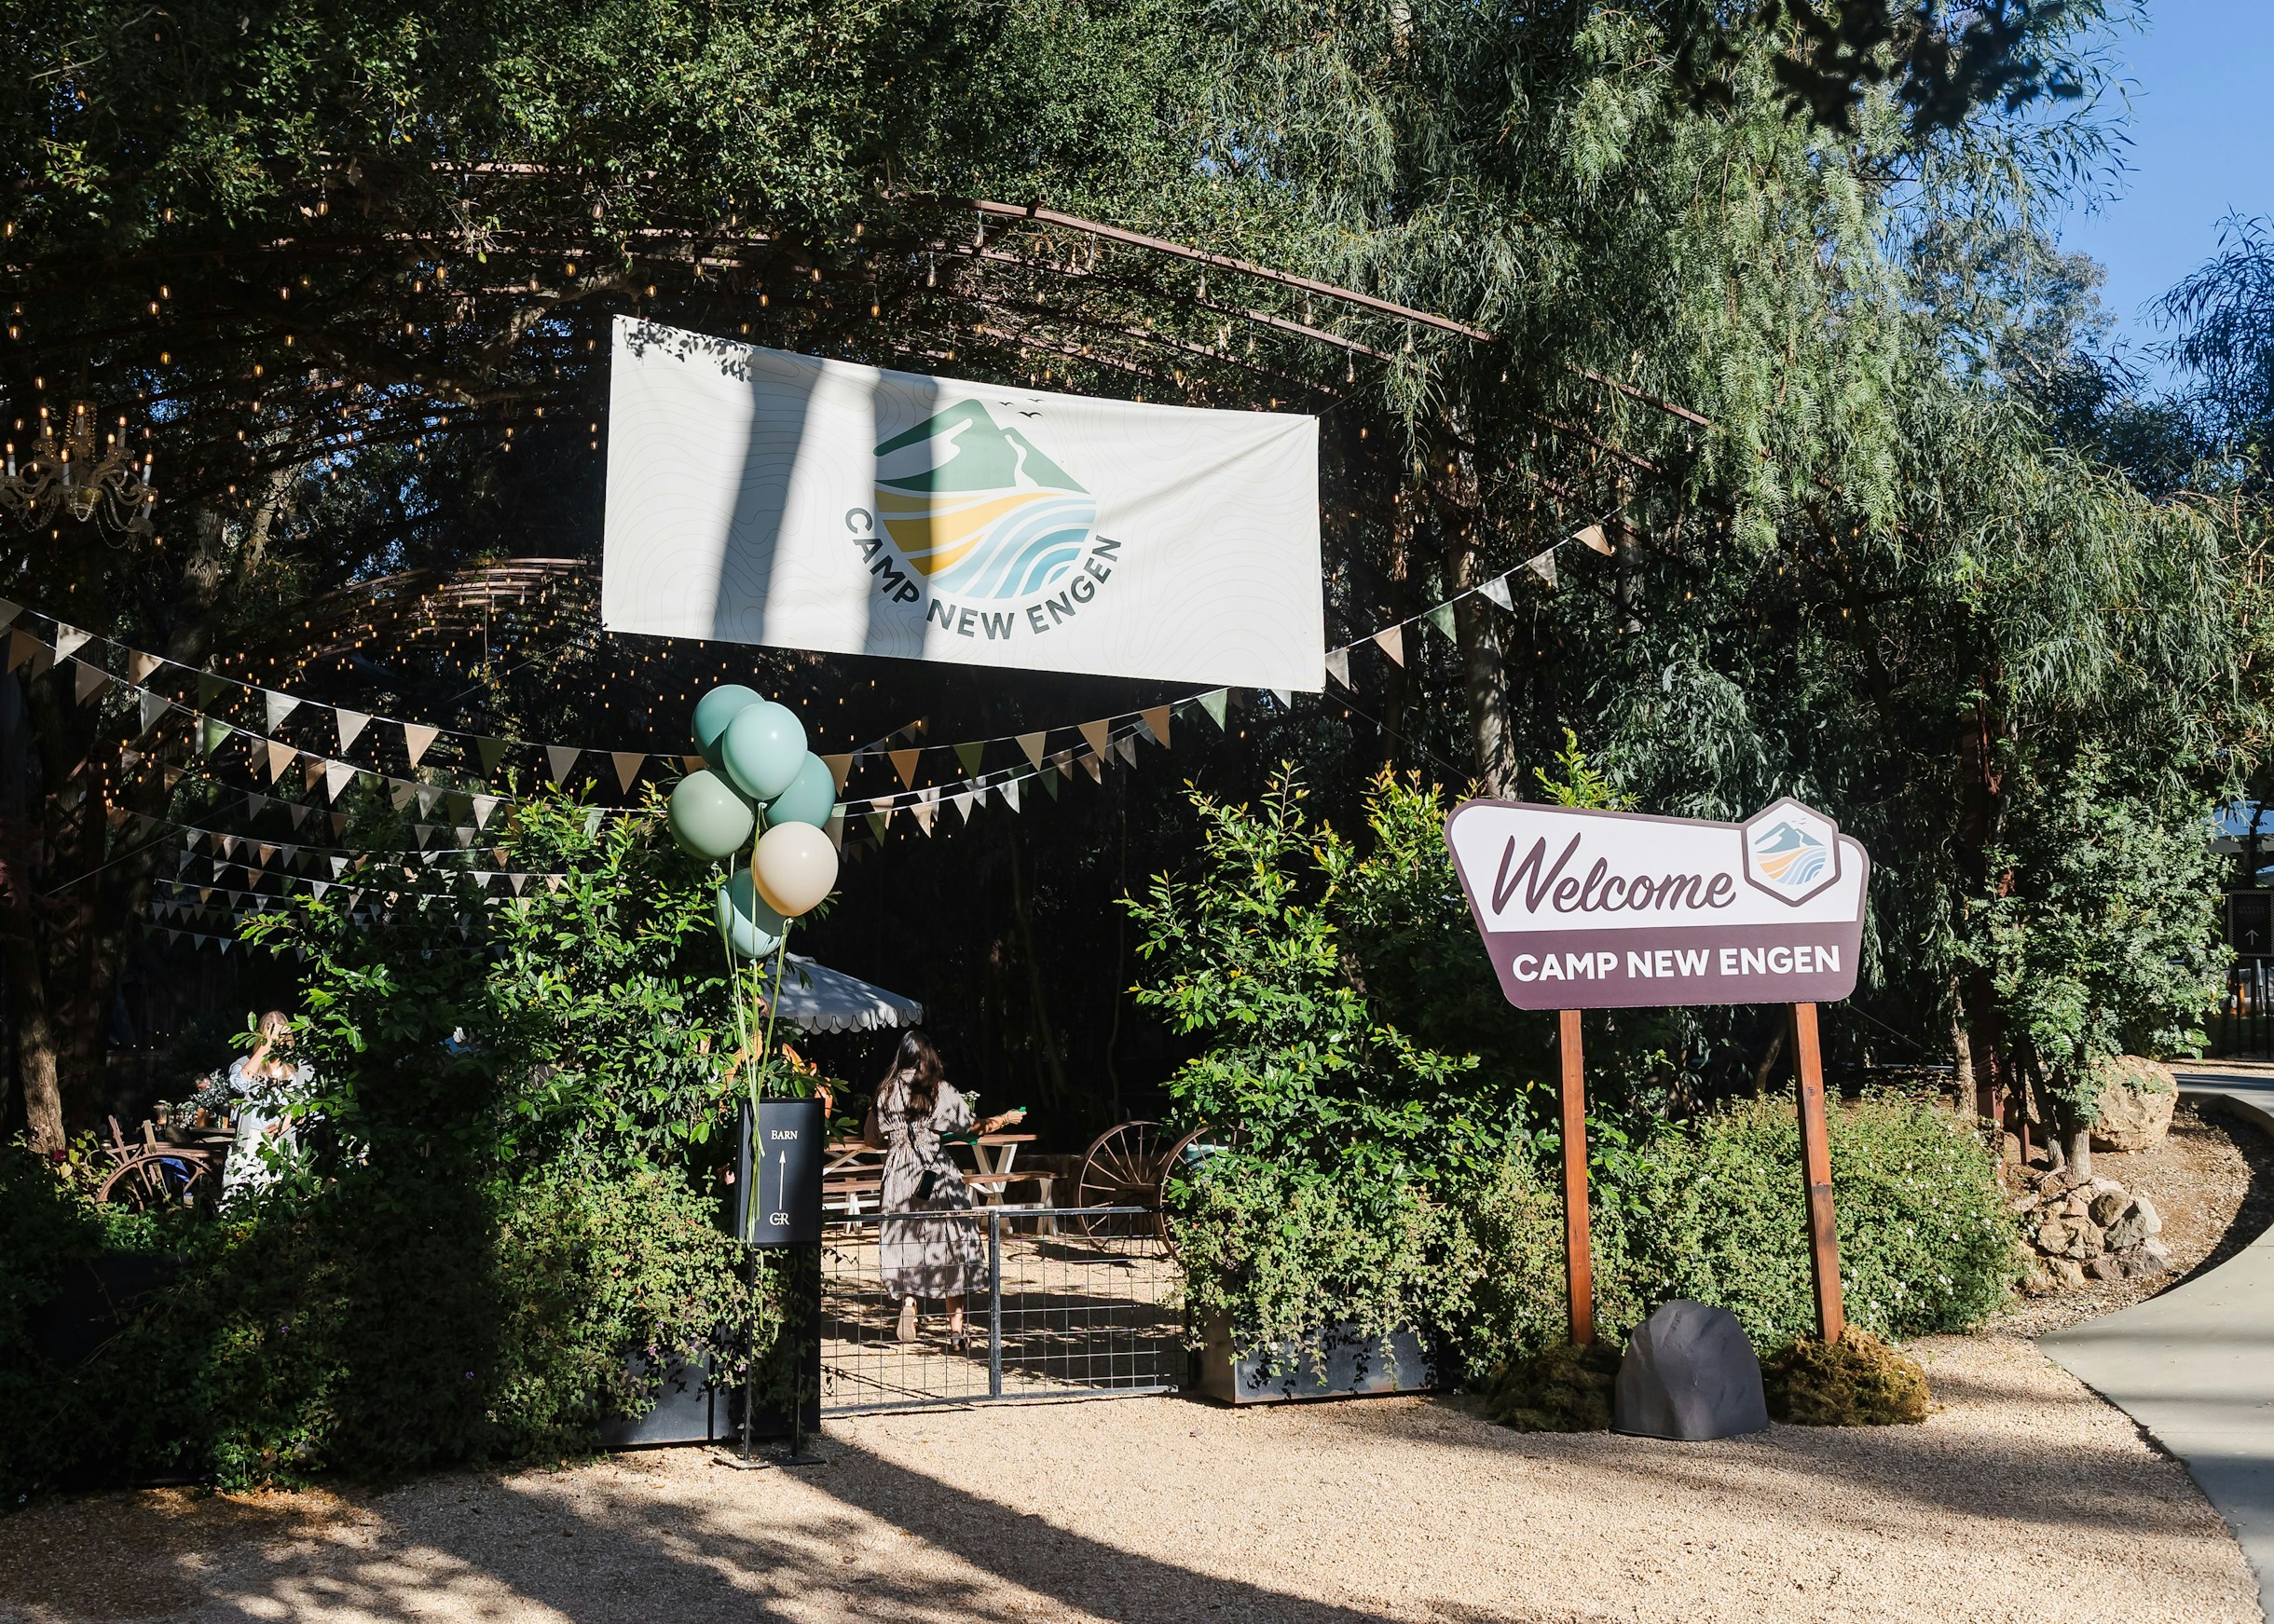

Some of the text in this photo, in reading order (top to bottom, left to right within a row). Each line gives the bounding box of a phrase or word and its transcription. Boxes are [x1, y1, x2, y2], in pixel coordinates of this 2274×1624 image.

[845, 507, 1122, 640] CAMP NEW ENGEN
[1491, 831, 1737, 916] Welcome
[1512, 945, 1842, 982] CAMP NEW ENGEN
[771, 1129, 799, 1140] BARN
